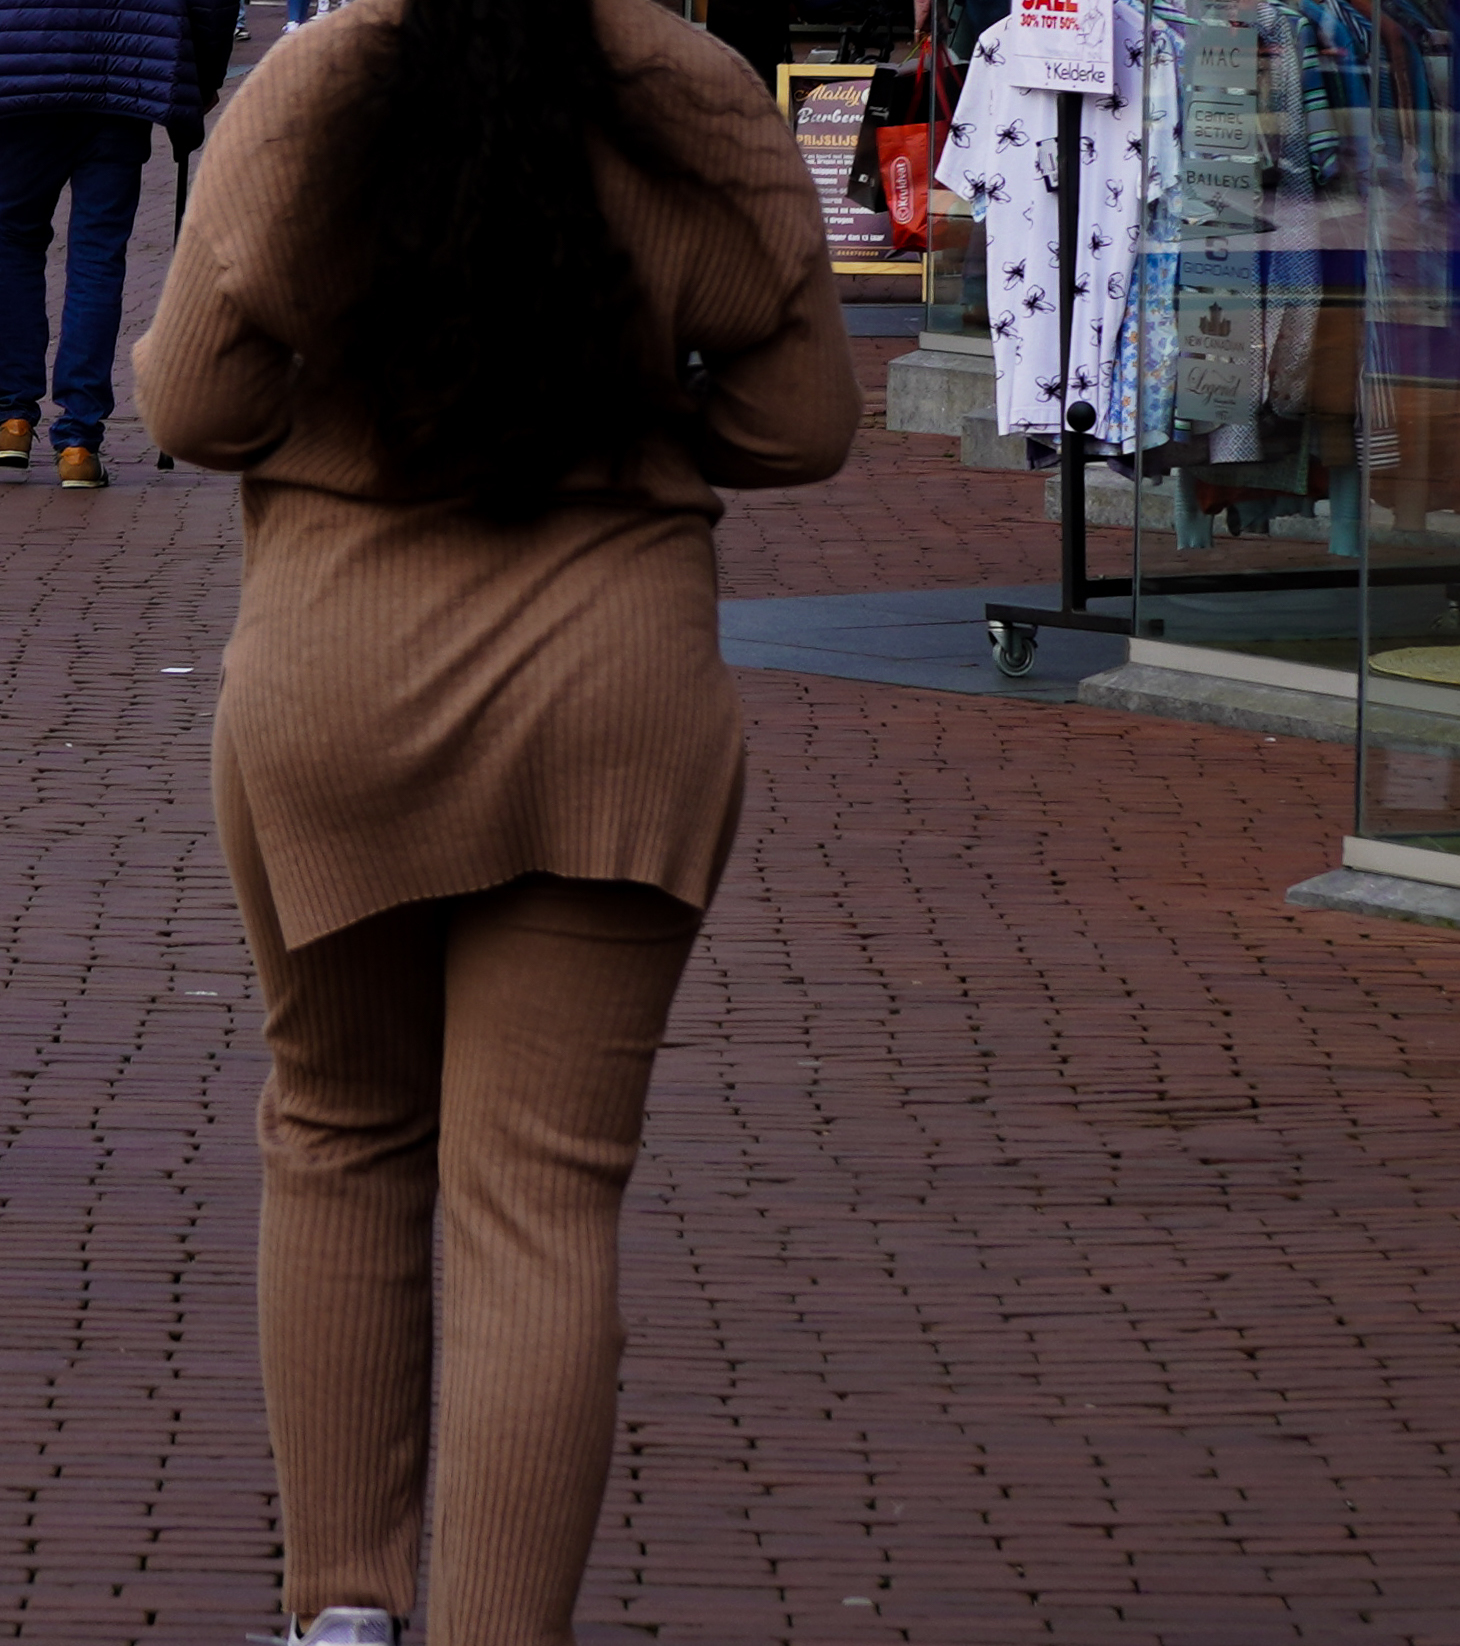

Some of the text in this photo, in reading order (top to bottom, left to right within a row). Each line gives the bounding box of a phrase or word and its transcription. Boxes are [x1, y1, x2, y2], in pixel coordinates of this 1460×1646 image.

[1020, 13, 1081, 31] 30% TOT 50%
[1200, 47, 1241, 68] MAC
[1054, 62, 1105, 84] Kelderke
[1186, 171, 1251, 189] BAILEYS
[1183, 261, 1251, 281] GIORDANO
[1184, 336, 1245, 353] NEW CANADIAN
[1185, 366, 1242, 404] Legend
